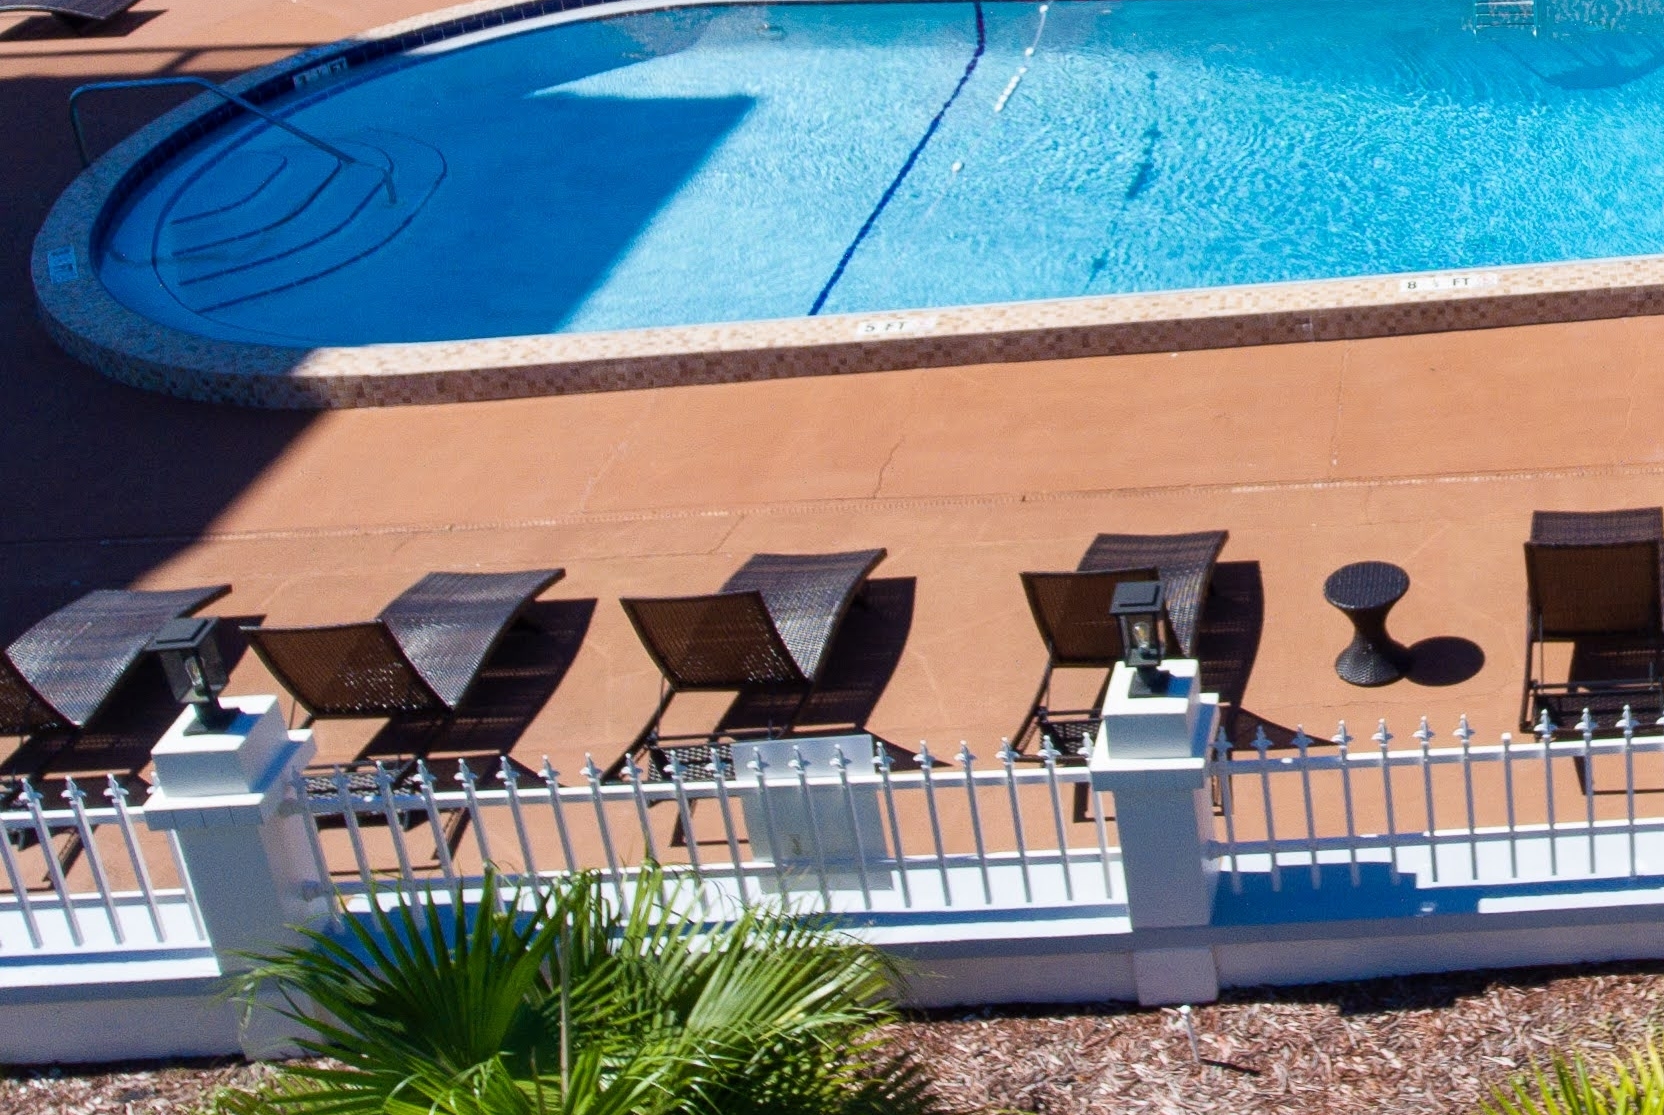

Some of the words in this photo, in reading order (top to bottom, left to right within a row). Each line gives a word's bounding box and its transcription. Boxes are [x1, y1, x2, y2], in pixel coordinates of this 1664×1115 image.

[1407, 280, 1417, 289] 8
[1453, 277, 1471, 286] FT
[864, 323, 876, 332] 5
[885, 321, 907, 331] FT
